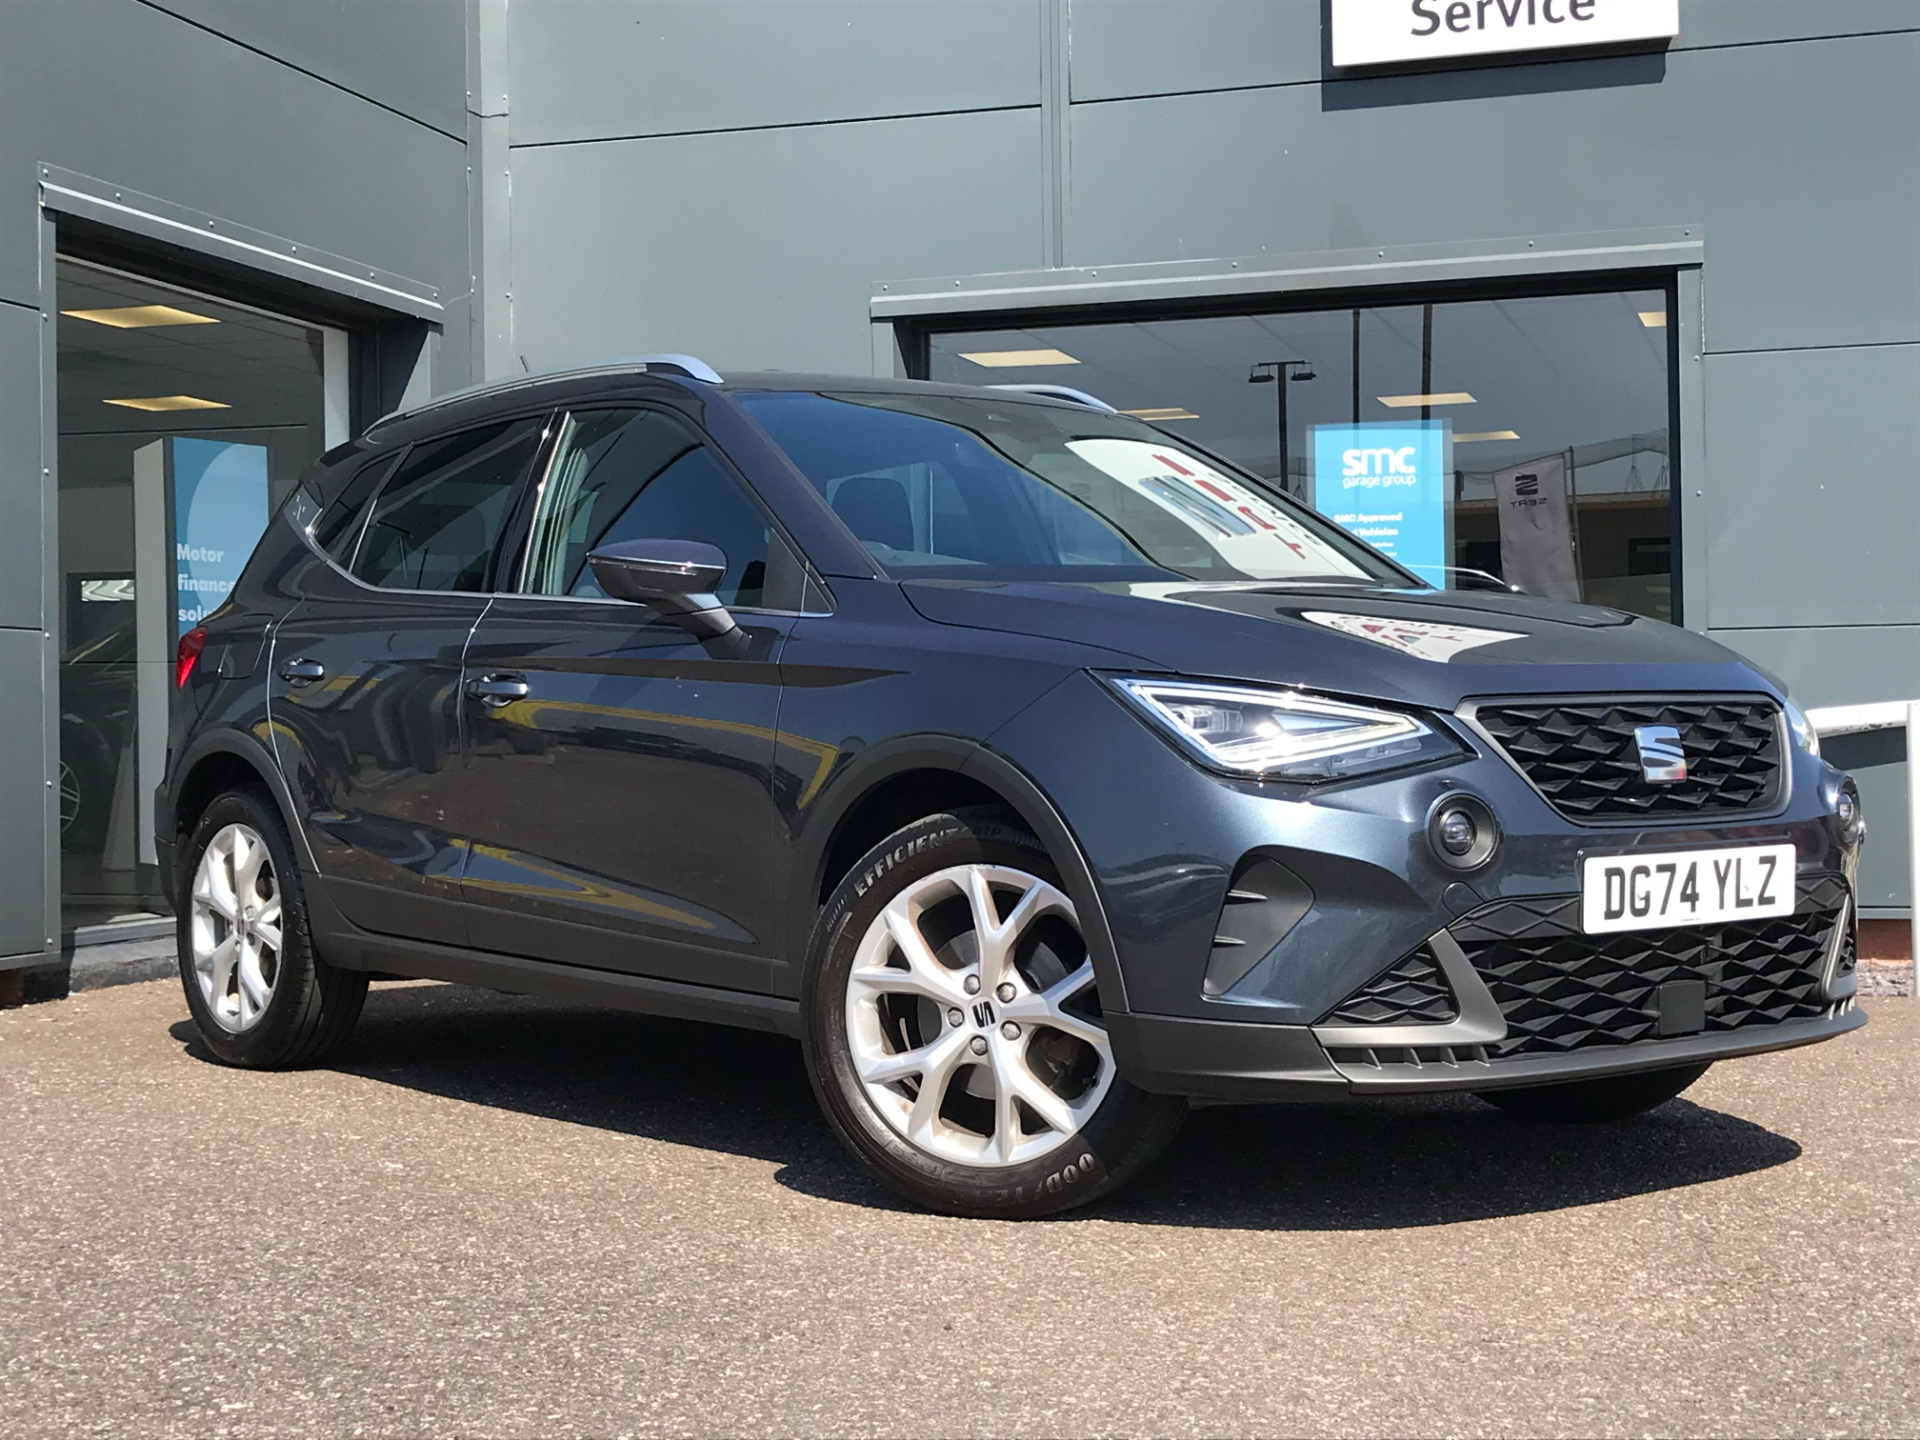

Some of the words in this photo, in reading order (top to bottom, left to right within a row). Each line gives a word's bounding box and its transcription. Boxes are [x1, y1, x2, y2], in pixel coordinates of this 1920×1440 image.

[1410, 0, 1595, 37] Service
[1342, 446, 1416, 476] smc
[1342, 476, 1381, 489] garage
[1382, 474, 1417, 487] group
[1334, 513, 1356, 524] SMC
[1357, 511, 1403, 524] Approved
[1359, 527, 1399, 537] Vehicles
[177, 543, 224, 562] Motor
[1604, 861, 1700, 920] DG74
[1713, 855, 1777, 910] YLZ
